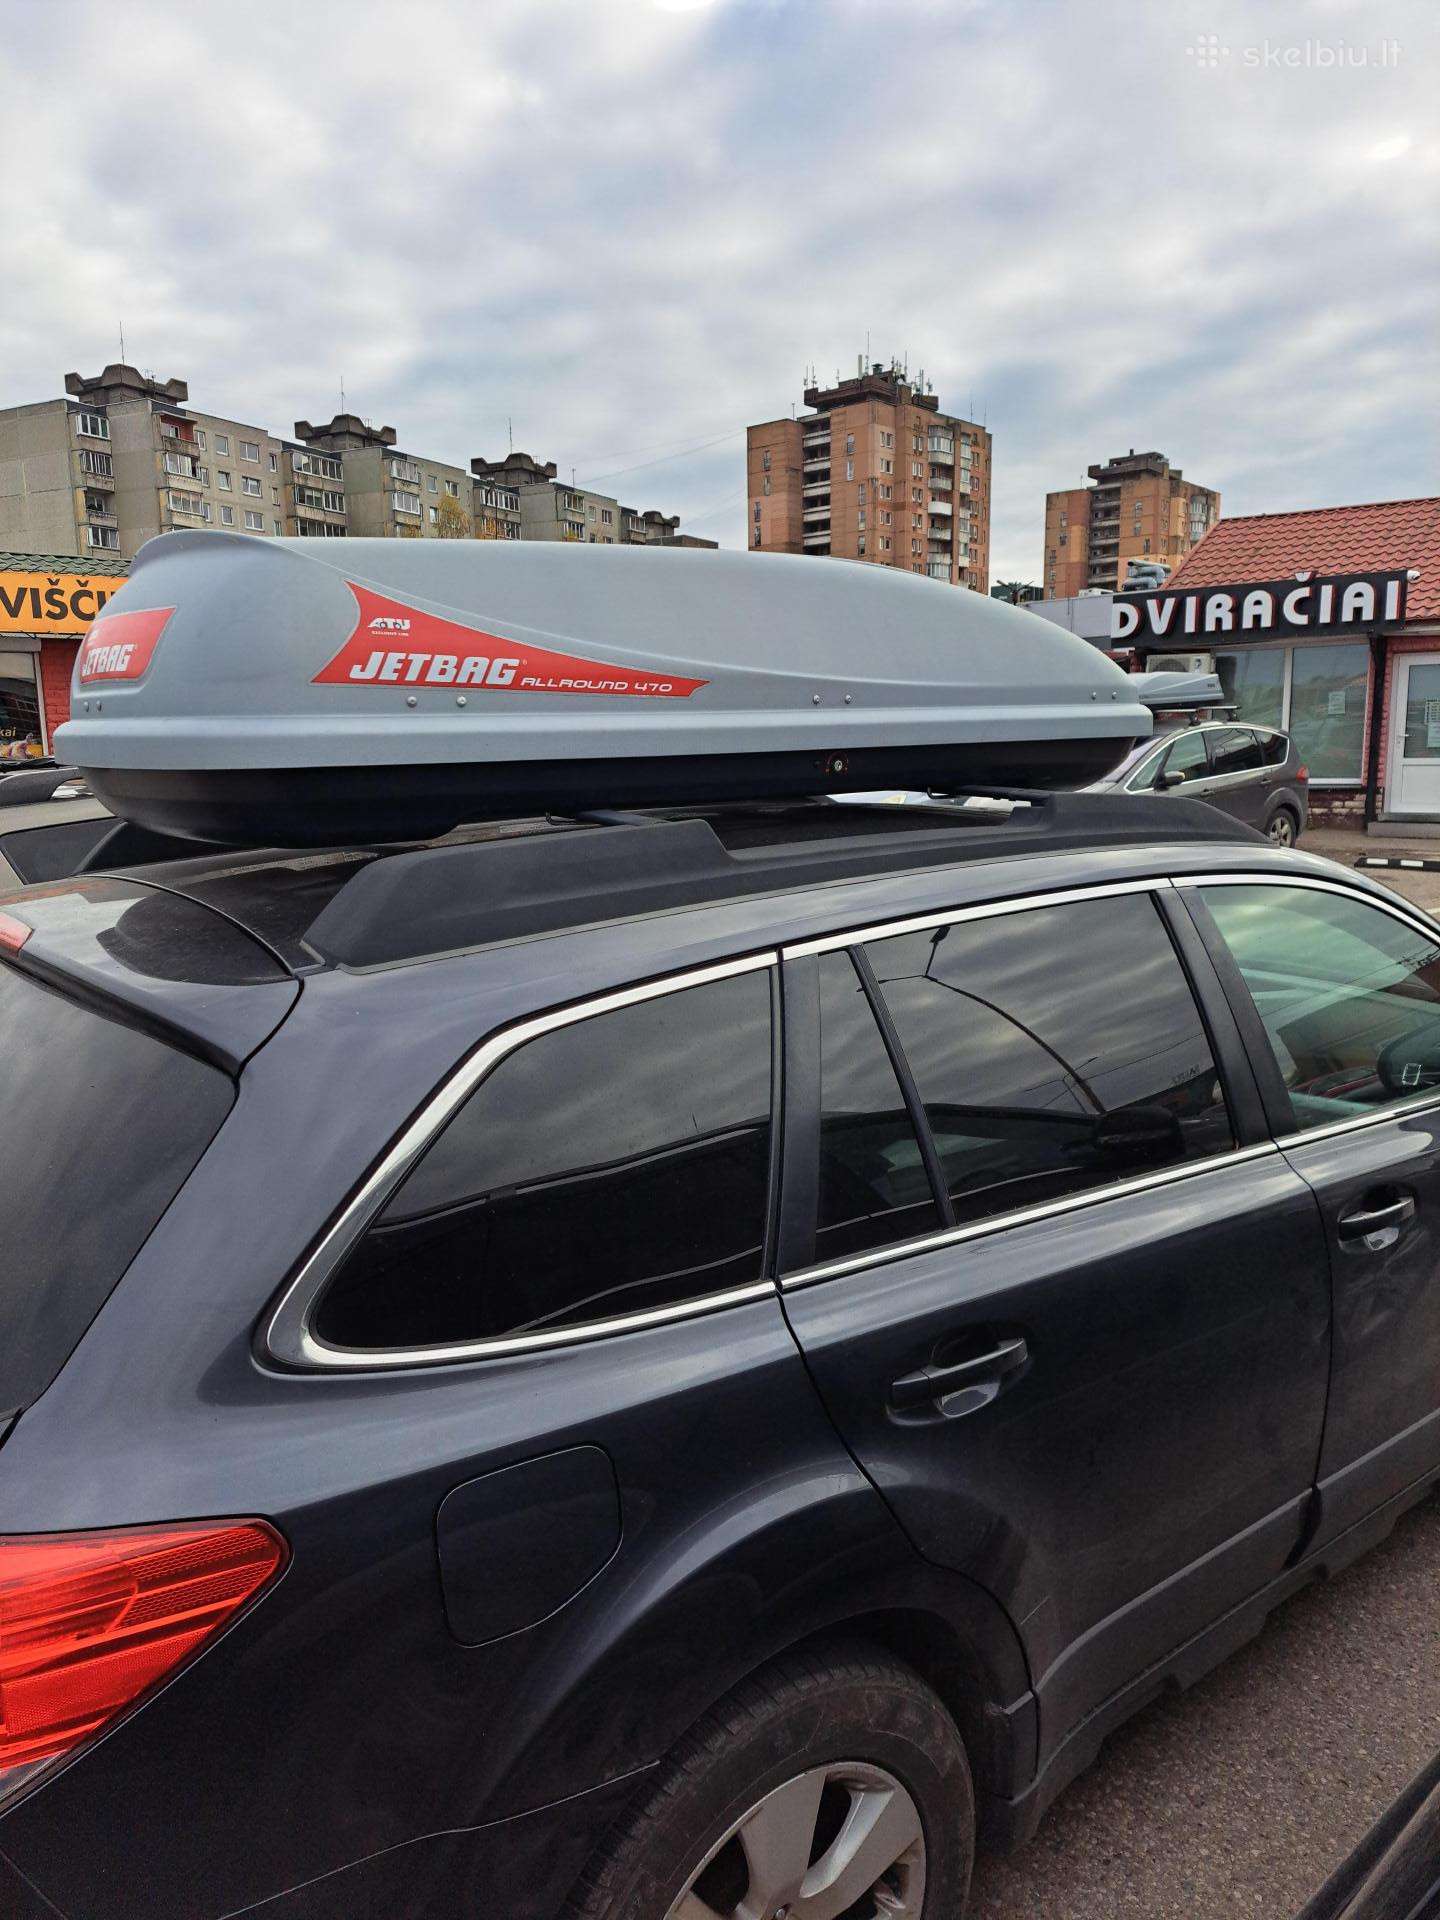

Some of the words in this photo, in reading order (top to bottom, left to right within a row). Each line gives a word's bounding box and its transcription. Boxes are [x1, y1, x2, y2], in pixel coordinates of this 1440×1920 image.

[0, 577, 115, 621] VIŠČI
[1111, 571, 1399, 639] DVIRAČIAI
[349, 651, 520, 685] JETBAG
[519, 676, 628, 690] ALLROUND
[634, 682, 673, 692] 470
